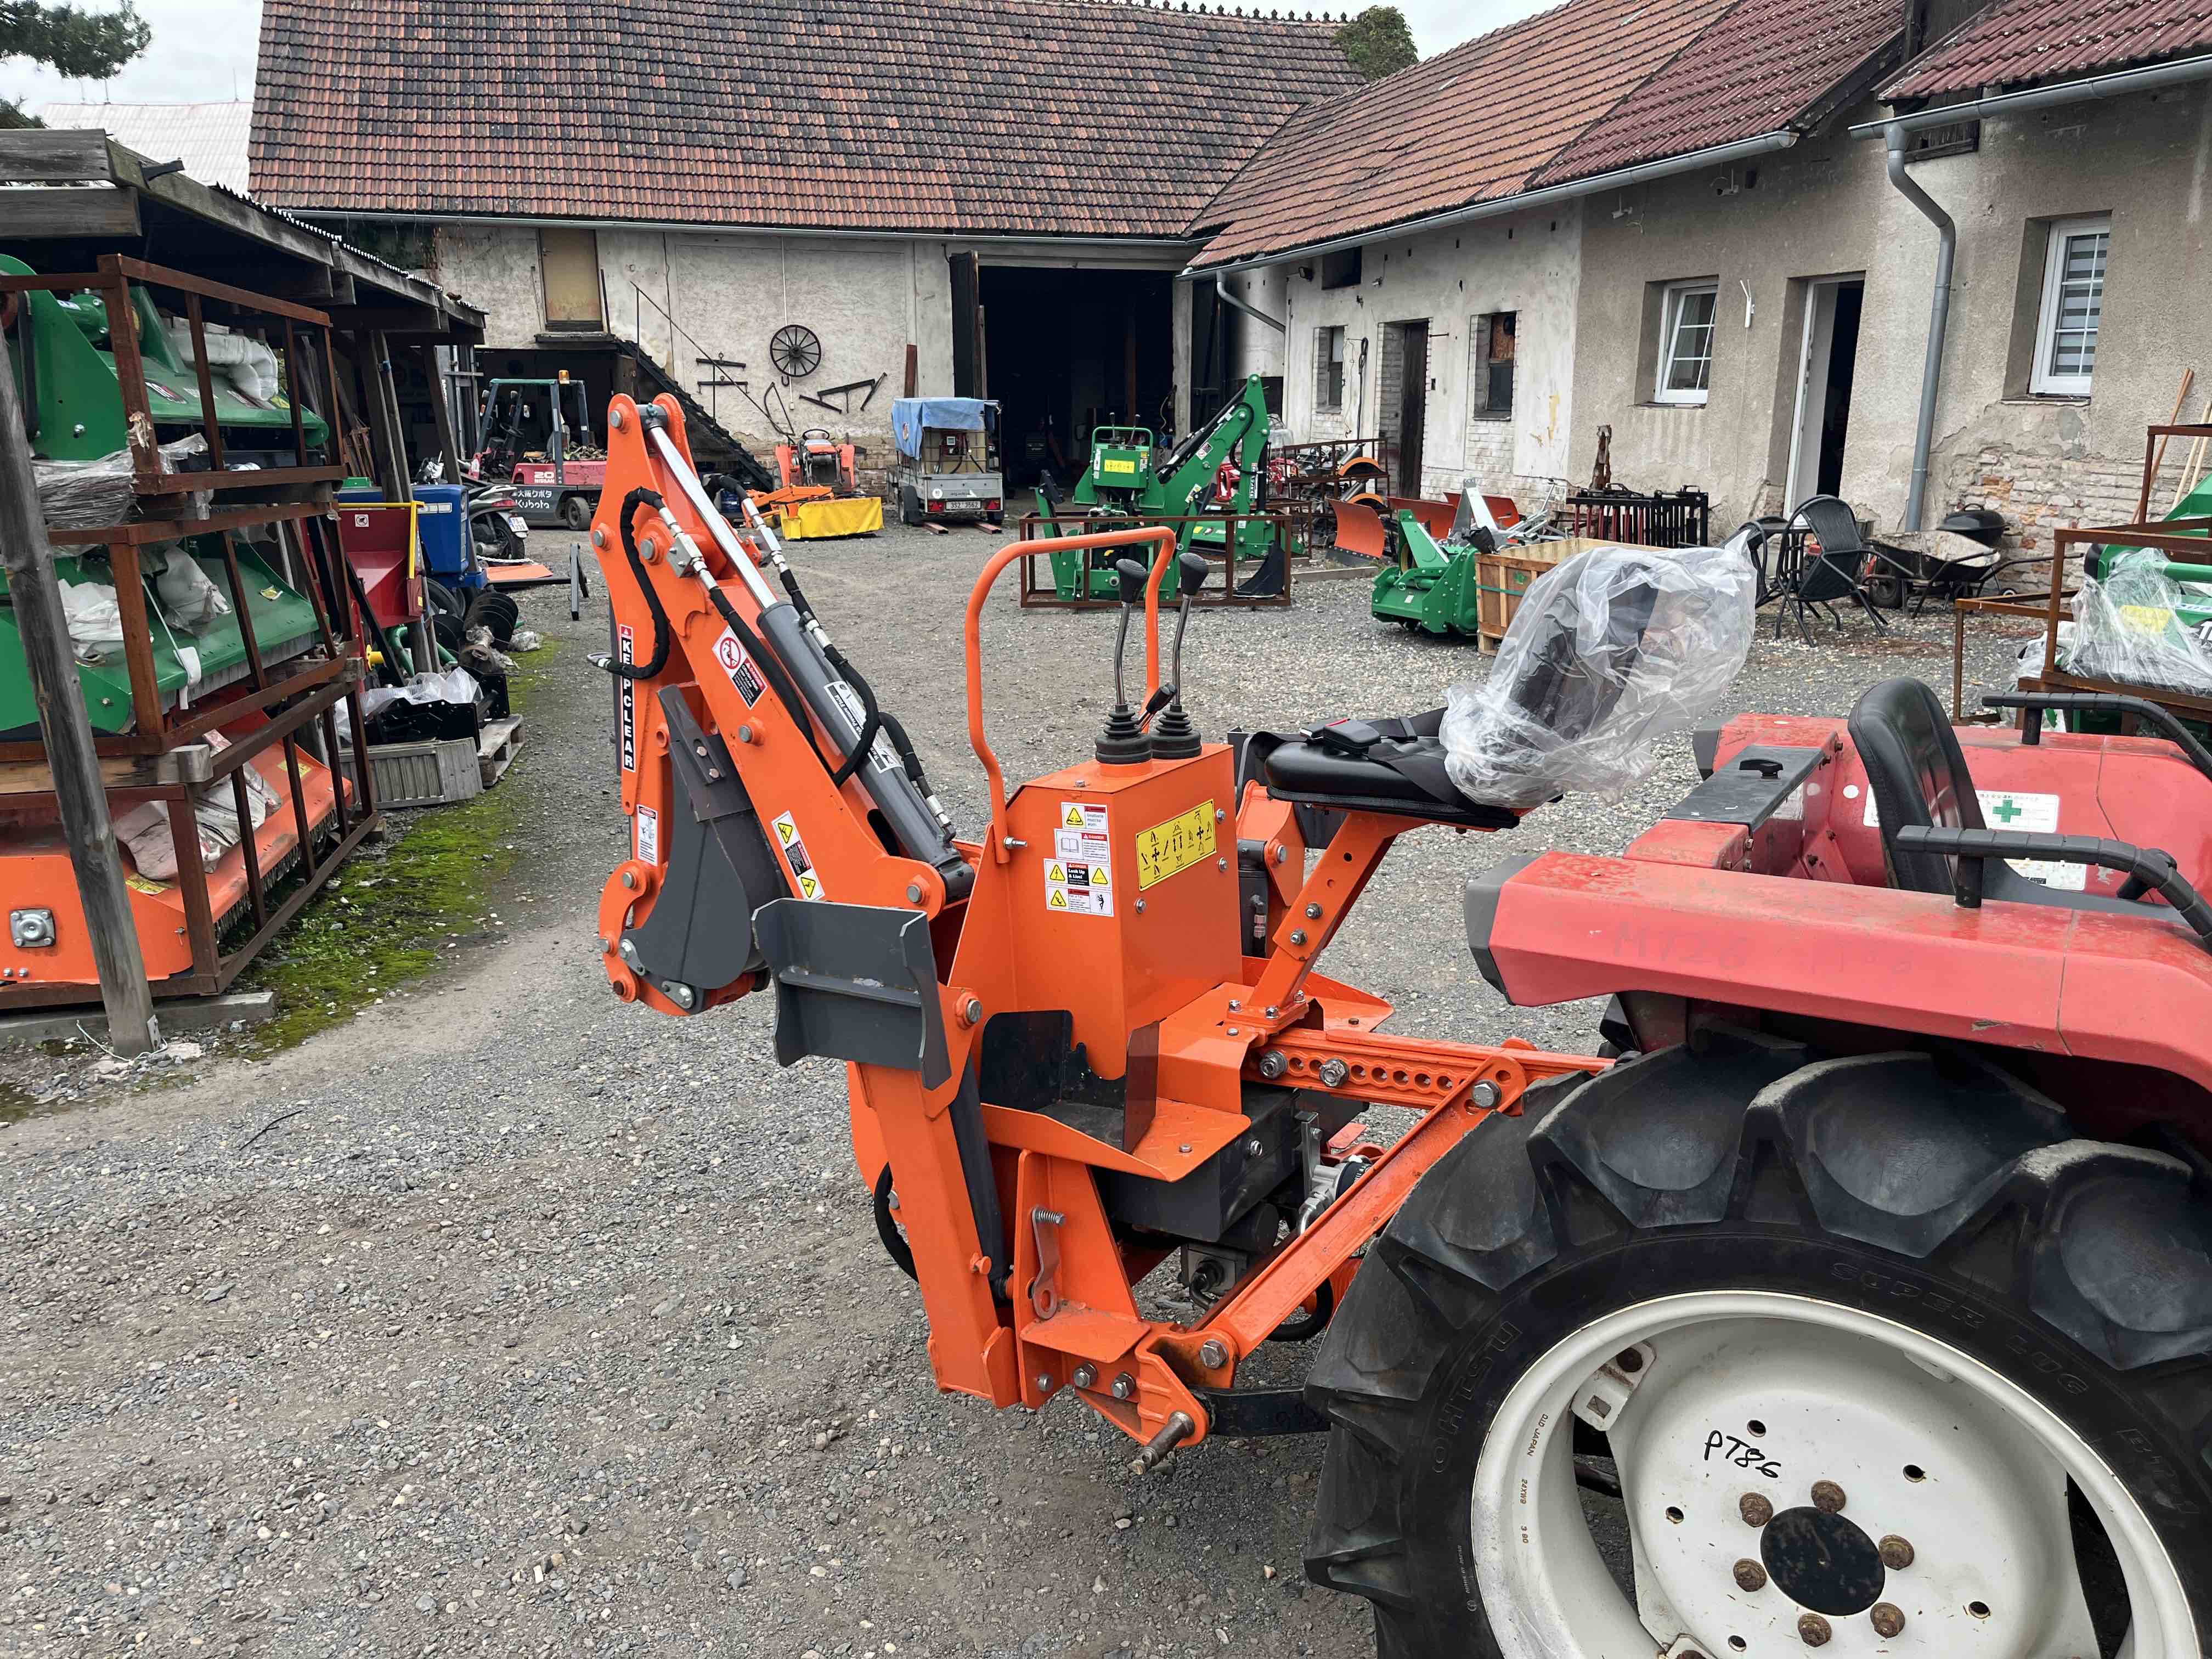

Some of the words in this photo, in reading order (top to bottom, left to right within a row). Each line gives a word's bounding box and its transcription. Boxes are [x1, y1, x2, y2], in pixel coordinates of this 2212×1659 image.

[515, 499, 550, 509] Kubota
[622, 640, 631, 690] KEP
[834, 694, 845, 707] Fluid
[623, 695, 634, 768] CLEAR
[1432, 1320, 1523, 1474] OHTSU
[1527, 1427, 1541, 1457] JAPAN
[1703, 1429, 1782, 1479] PT86
